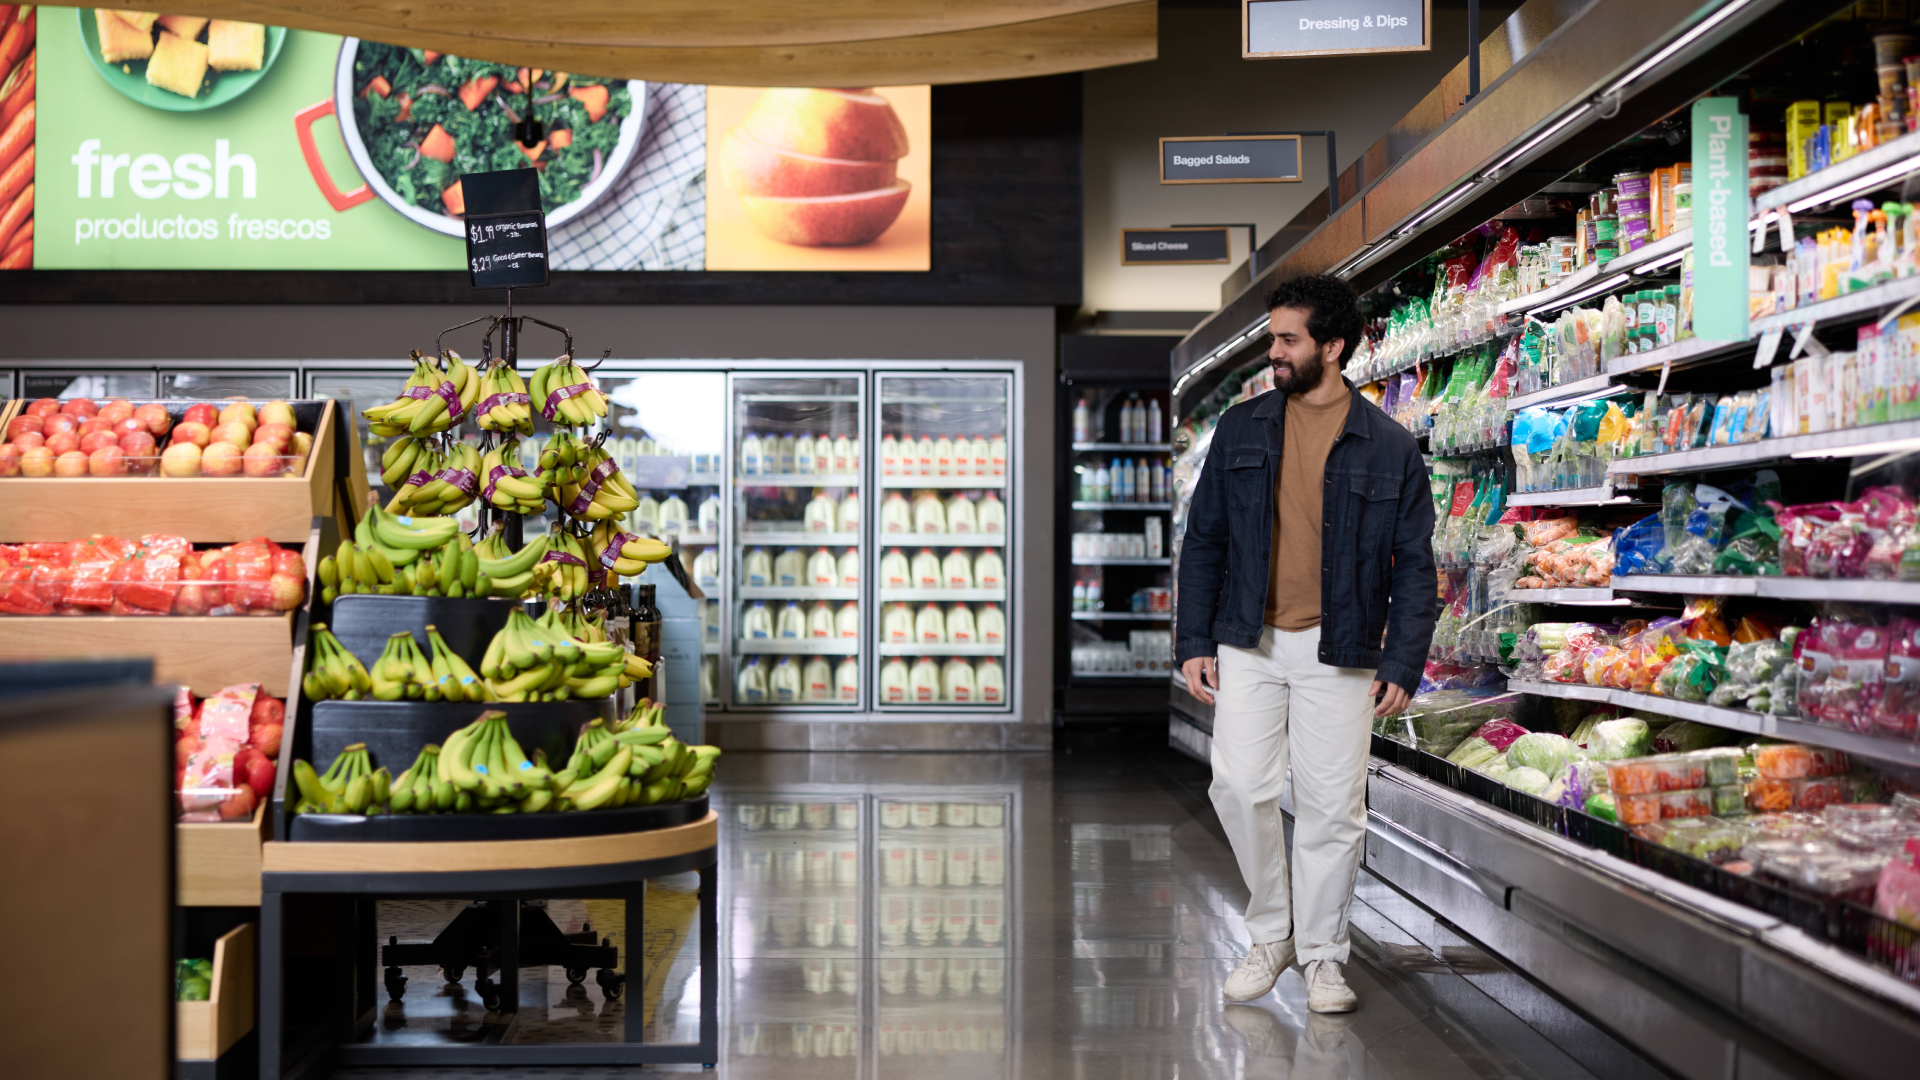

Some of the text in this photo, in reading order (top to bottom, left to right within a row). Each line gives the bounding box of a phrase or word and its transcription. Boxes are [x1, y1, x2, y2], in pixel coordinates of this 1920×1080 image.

[1299, 14, 1408, 31] Dressing & Dips
[72, 139, 257, 200] fresh
[1173, 153, 1251, 167] Bagged Salads
[1709, 115, 1732, 267] Plant-based
[75, 212, 332, 245] productos frescos
[470, 224, 494, 244] $1.99
[1131, 241, 1189, 252] Sliced Cheese
